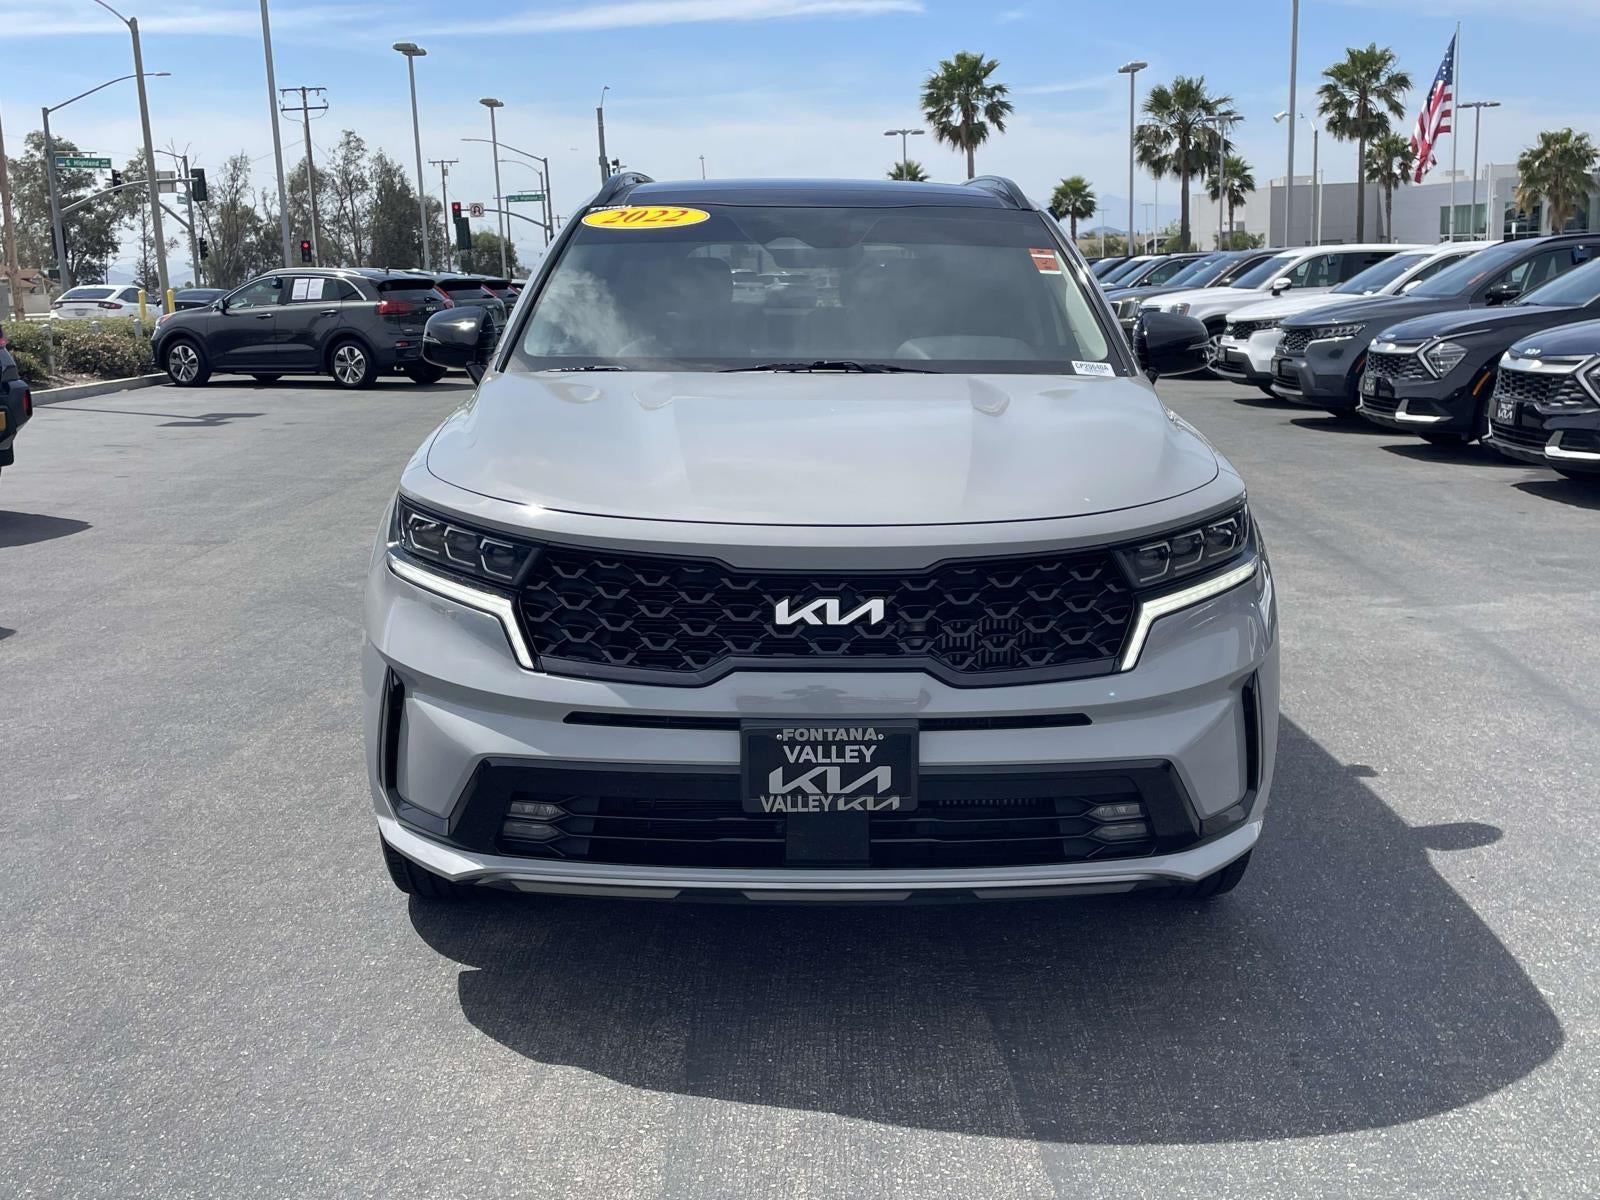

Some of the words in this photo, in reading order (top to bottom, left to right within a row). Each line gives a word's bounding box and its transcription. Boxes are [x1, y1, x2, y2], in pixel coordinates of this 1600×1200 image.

[601, 209, 689, 224] 2022
[775, 598, 884, 625] KIA
[783, 728, 878, 741] FONTANA
[783, 745, 877, 764] VALLEY
[768, 765, 892, 794] KIA
[760, 794, 834, 812] VALLEY
[837, 796, 901, 811] KIA
